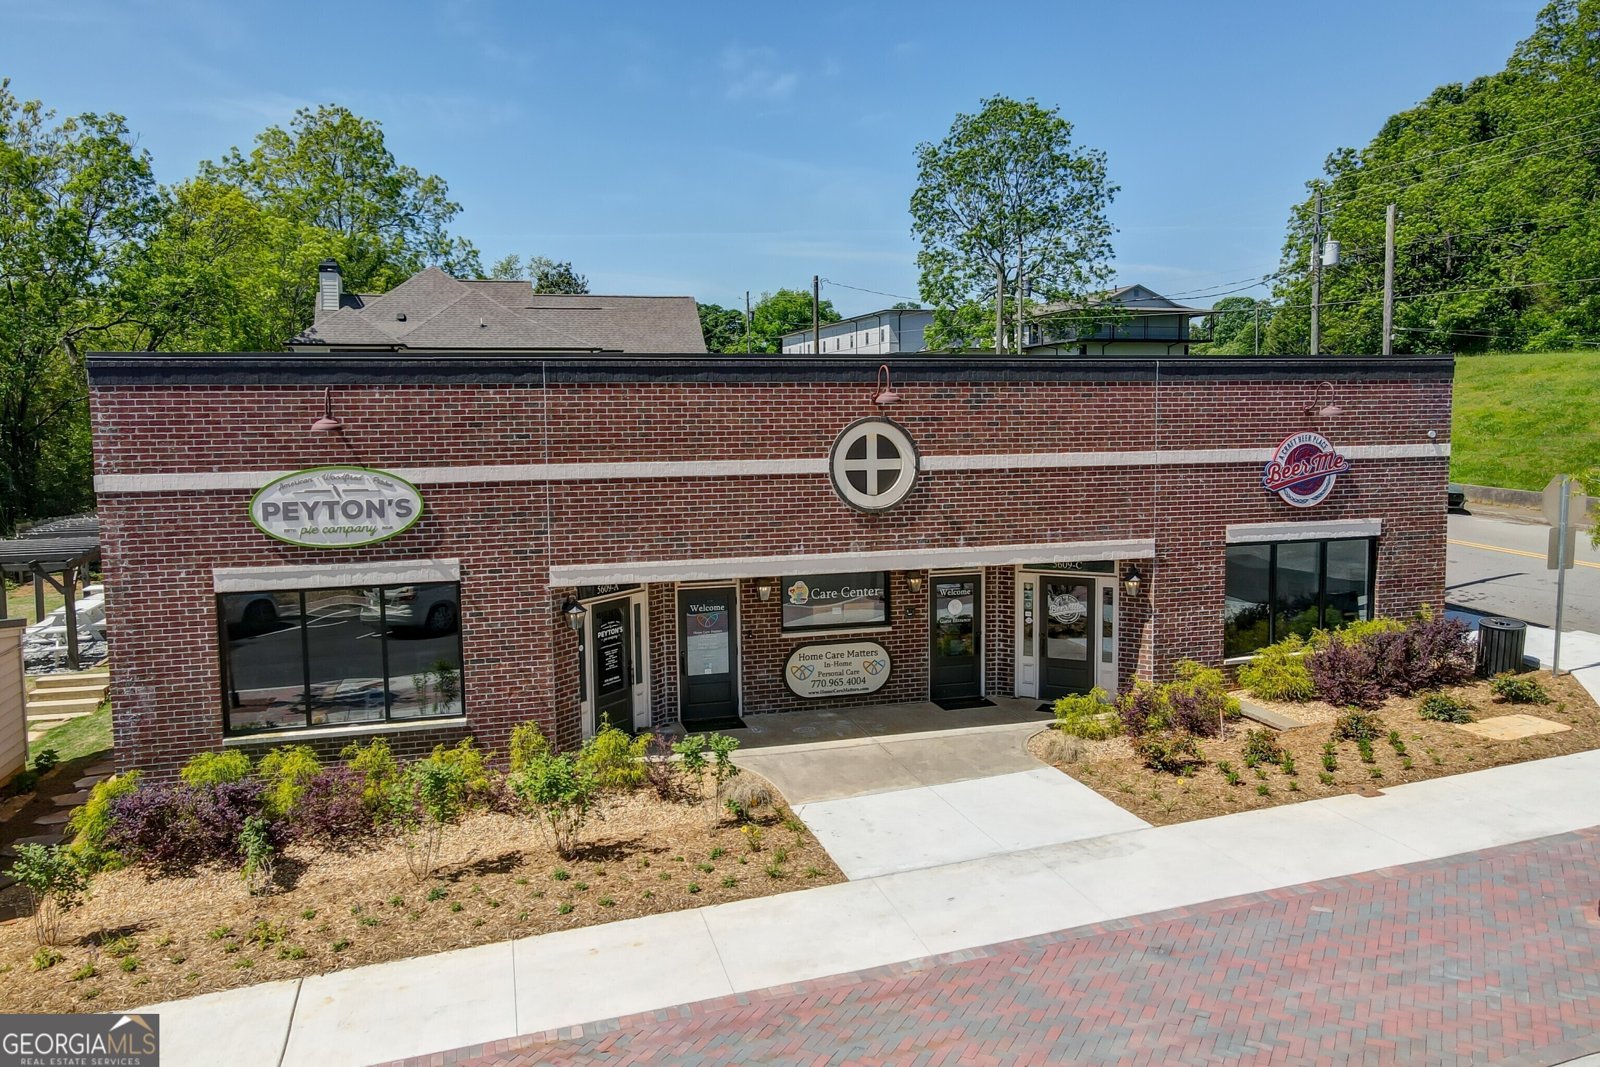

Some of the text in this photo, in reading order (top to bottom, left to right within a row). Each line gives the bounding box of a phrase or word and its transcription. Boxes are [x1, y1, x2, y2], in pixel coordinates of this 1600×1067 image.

[1281, 438, 1298, 454] CRAFT
[1298, 434, 1312, 443] BEER
[1313, 435, 1329, 450] PLACE
[1266, 451, 1345, 484] Beer Me
[278, 477, 313, 491] American
[262, 498, 413, 522] PEYTON'S
[299, 525, 320, 539] pie
[321, 524, 378, 537] company
[597, 584, 619, 595] 5609-A
[811, 586, 880, 599] Care Center
[940, 588, 971, 596] Welcome
[690, 604, 725, 612] Welcome
[597, 626, 623, 639] PEYTON'S
[798, 649, 879, 661] Home Care Matters
[817, 668, 860, 677] Personal Care
[811, 676, 866, 688] 770.965.4004
